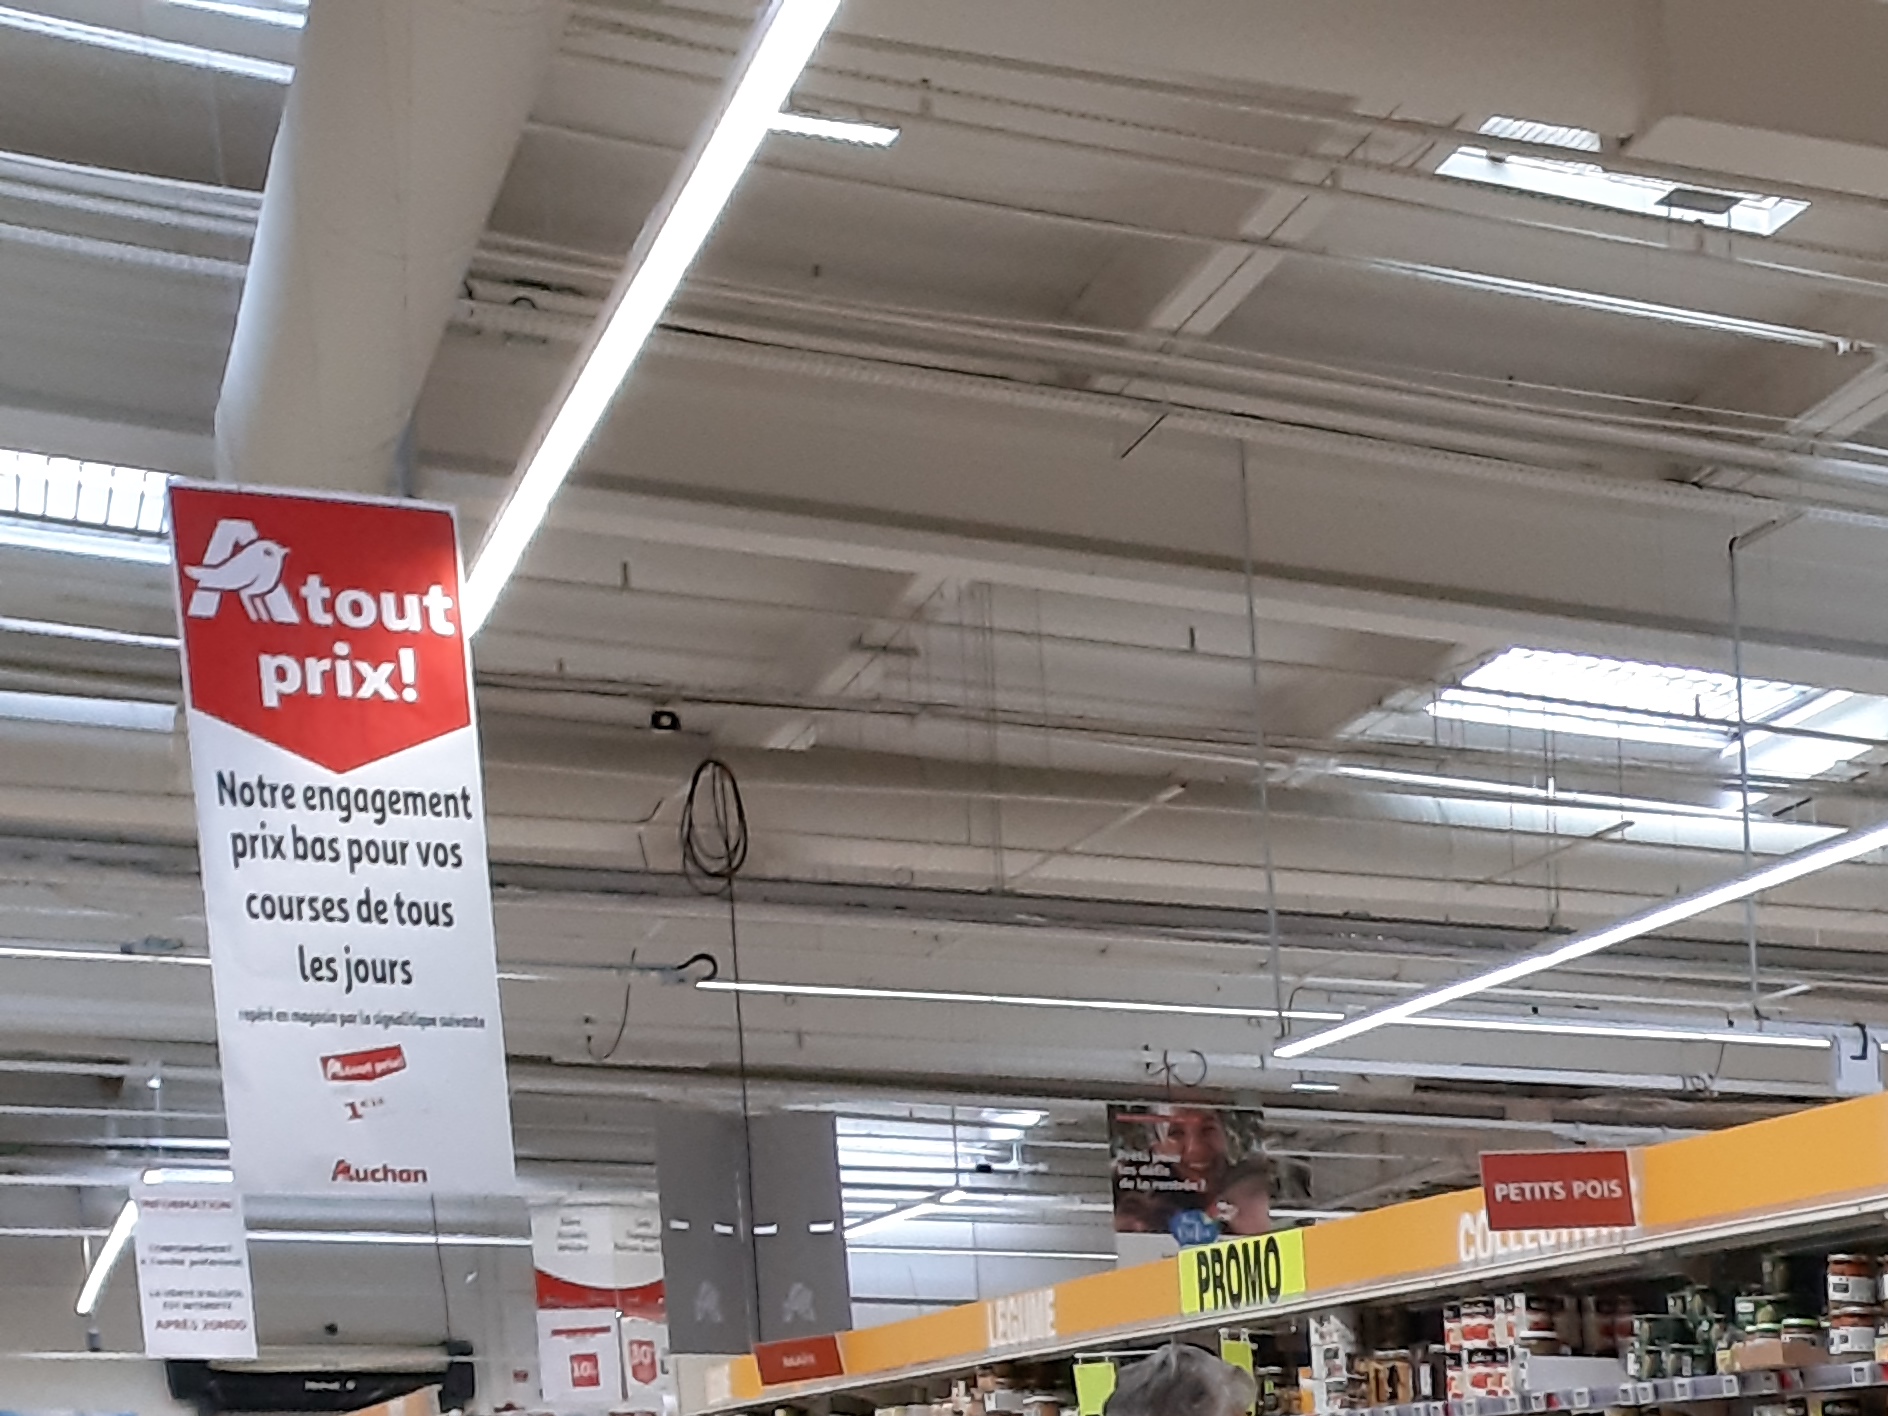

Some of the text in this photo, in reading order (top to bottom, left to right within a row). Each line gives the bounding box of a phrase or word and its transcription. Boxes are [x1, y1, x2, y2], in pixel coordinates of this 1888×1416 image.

[301, 574, 456, 636] tout
[259, 641, 419, 708] prix!
[216, 770, 473, 825] Notre engagement
[230, 821, 462, 874] prix bas pour vos
[246, 887, 454, 927] courses de tous
[298, 944, 413, 995] les jours
[331, 1159, 428, 1184] Auchan
[1494, 1179, 1623, 1202] PETITS POIS
[1196, 1235, 1282, 1313] PROMO
